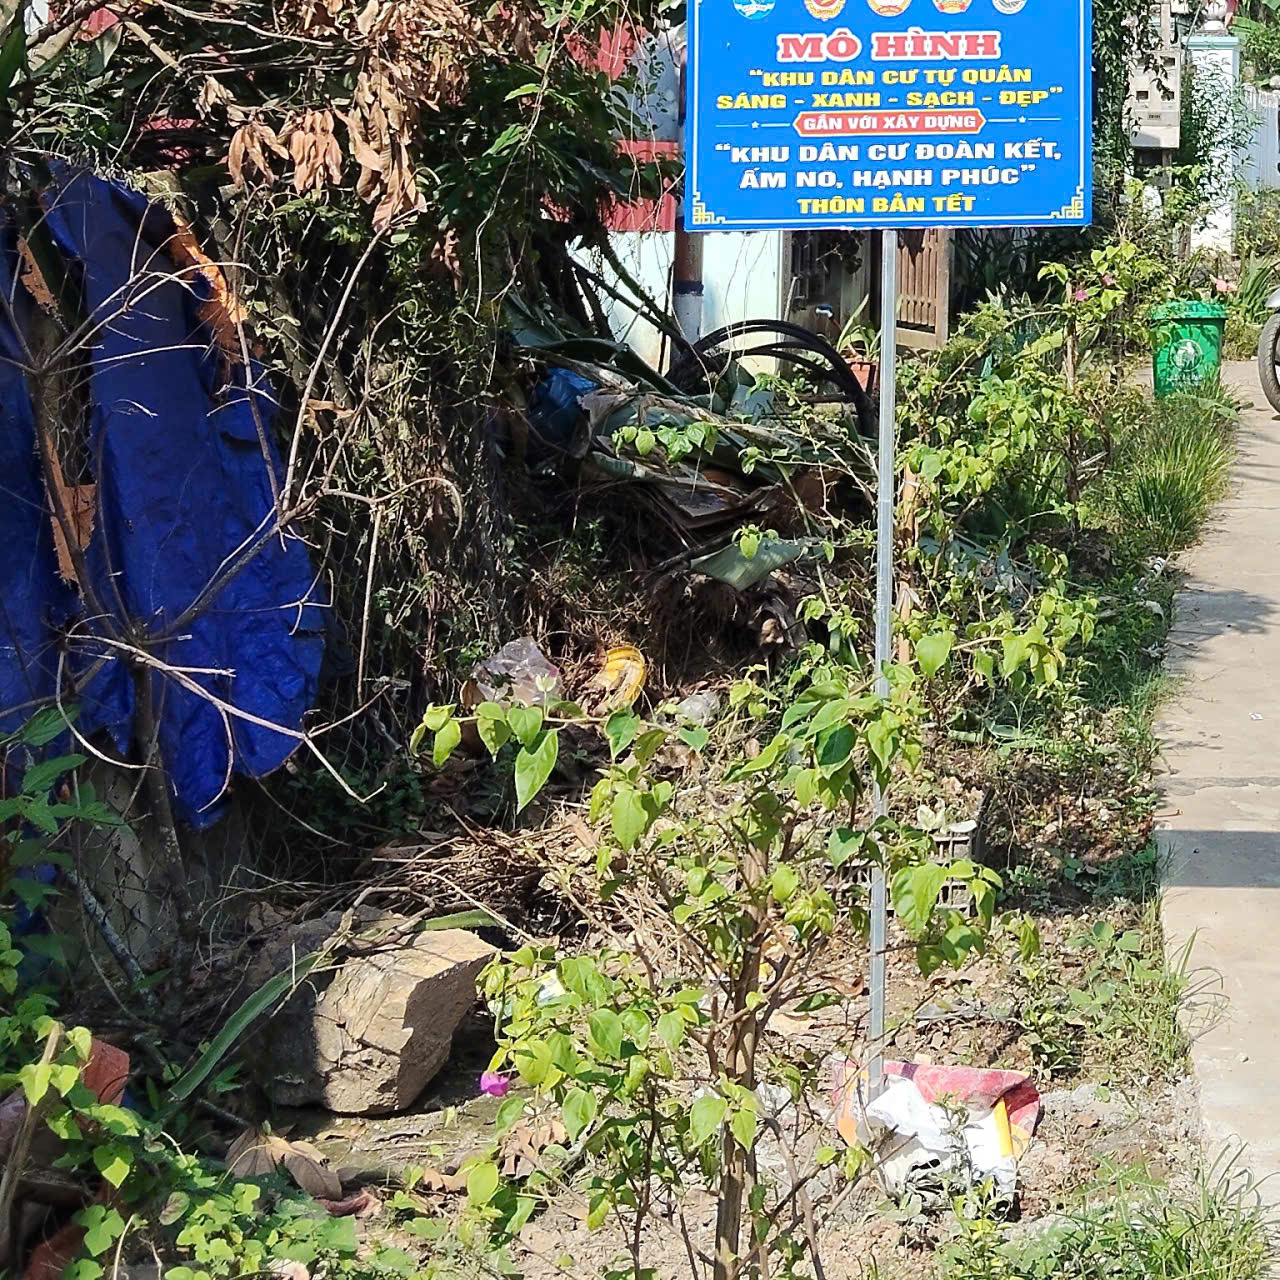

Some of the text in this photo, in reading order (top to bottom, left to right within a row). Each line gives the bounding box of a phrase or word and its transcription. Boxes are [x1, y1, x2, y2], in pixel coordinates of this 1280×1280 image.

[779, 28, 999, 60] MÔ HÌNH
[821, 68, 875, 86] DÂN
[882, 68, 919, 84] CƯ
[924, 68, 957, 86] TỰ
[962, 64, 1032, 84] QUẢN
[716, 92, 787, 109] SÁNG
[812, 92, 881, 107] XANH
[906, 91, 974, 109] SẠCH
[848, 116, 877, 130] VỚI
[883, 115, 920, 129] XÂY
[924, 115, 976, 131] DỰNG
[799, 142, 859, 161] DÂN
[868, 142, 911, 161] CƯ
[915, 140, 995, 160] ĐOÀN
[1004, 136, 1062, 160] KẾT,
[739, 167, 787, 189] ẤM
[796, 171, 843, 189] NO,
[852, 169, 933, 190] HẠNH
[797, 192, 976, 214] THÔN BẢN TẾT
